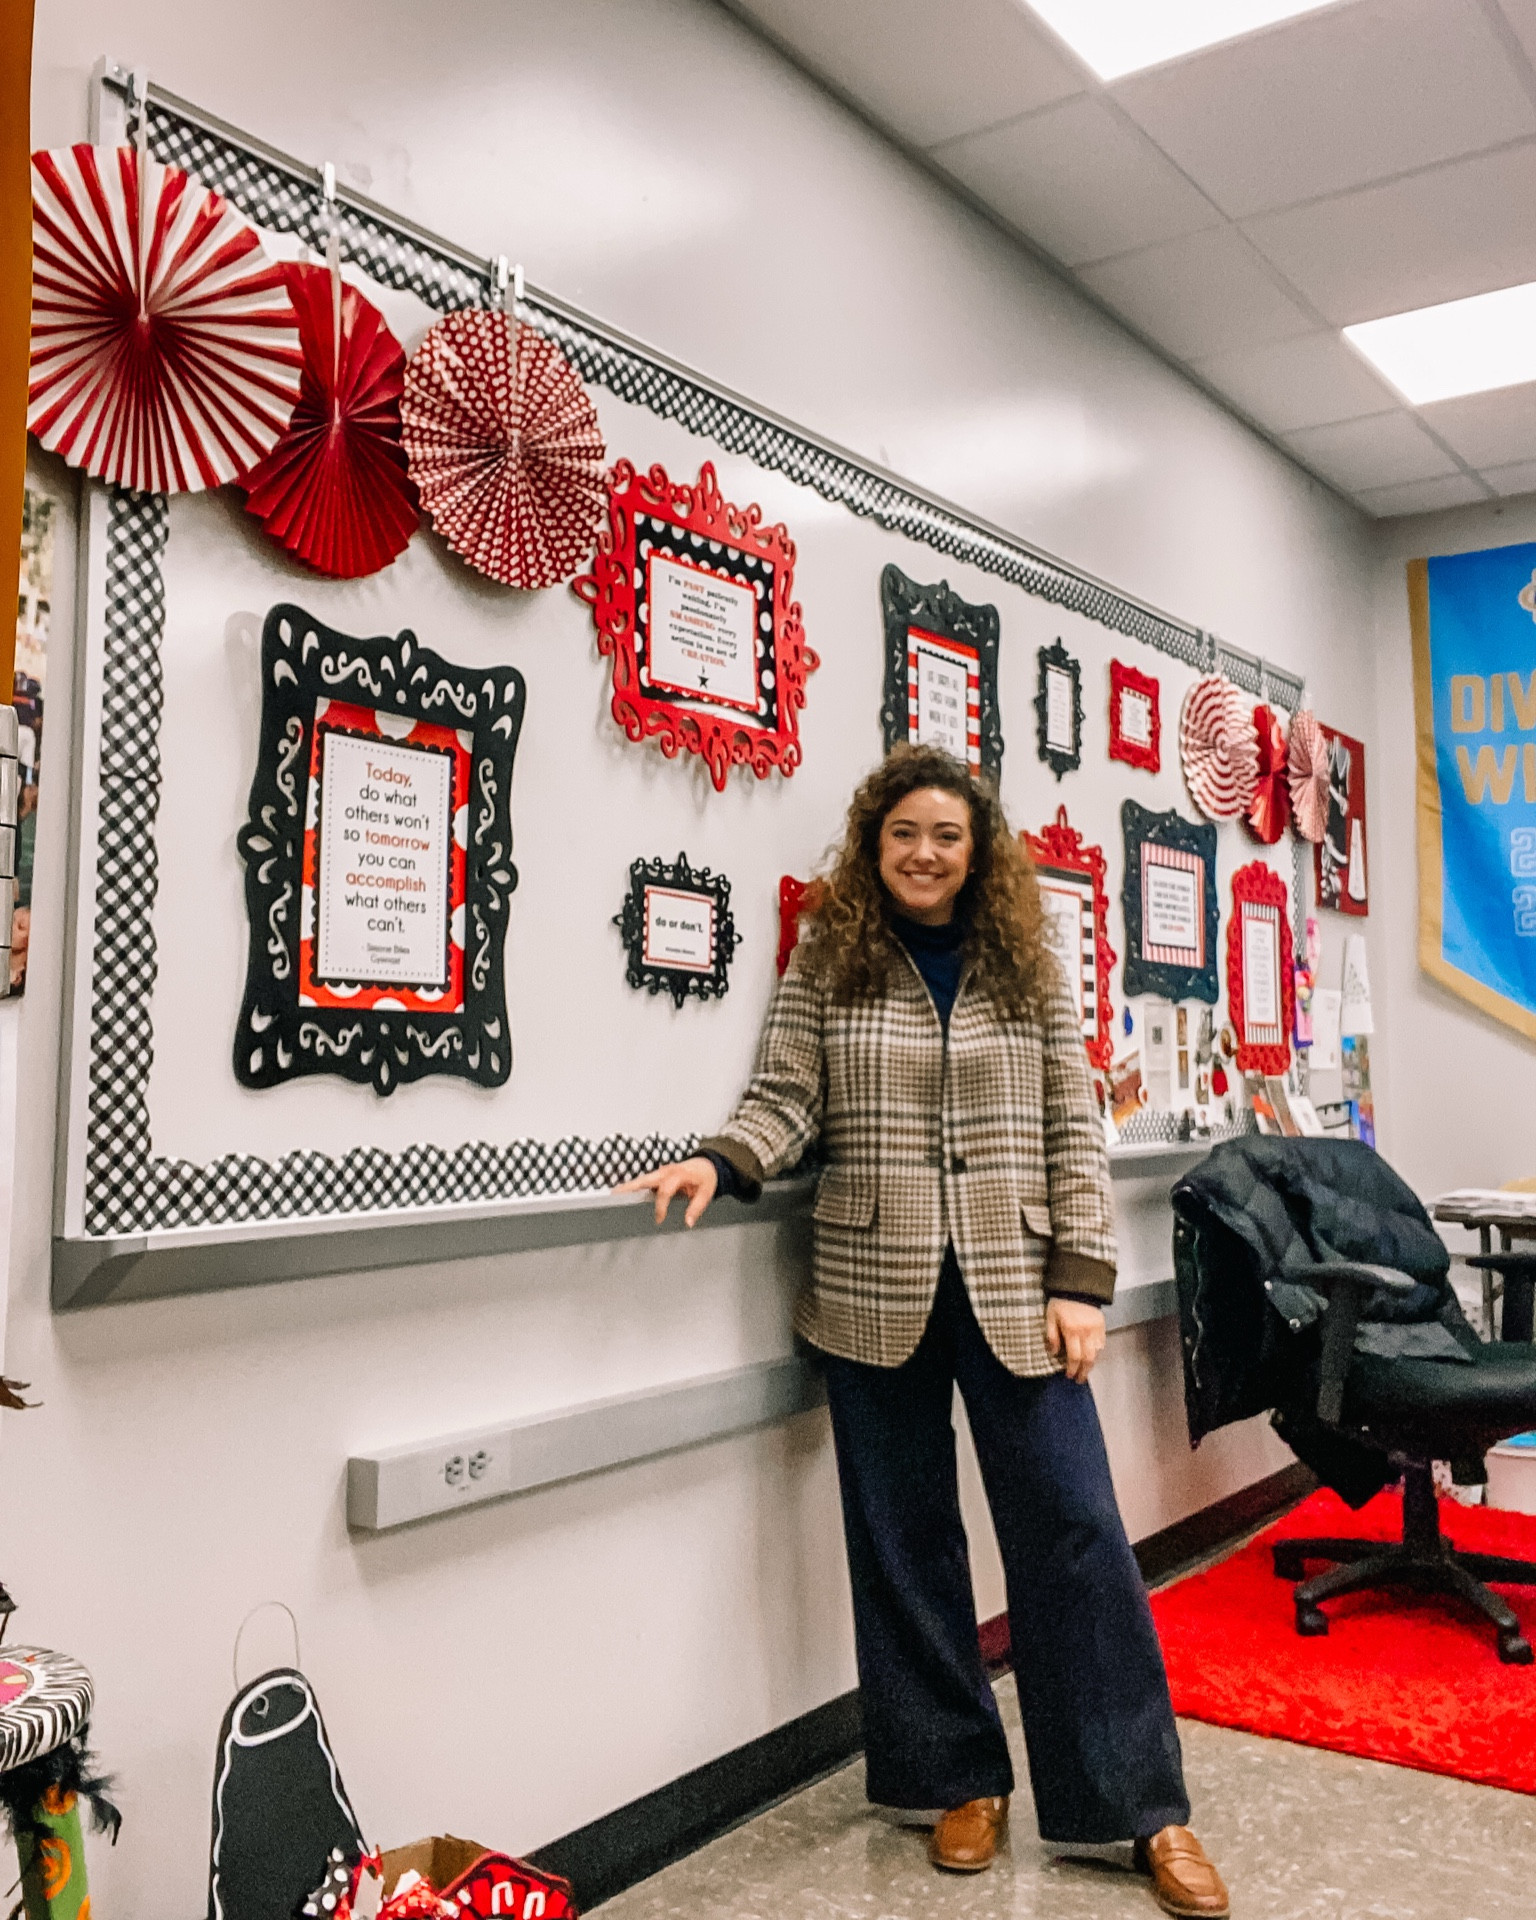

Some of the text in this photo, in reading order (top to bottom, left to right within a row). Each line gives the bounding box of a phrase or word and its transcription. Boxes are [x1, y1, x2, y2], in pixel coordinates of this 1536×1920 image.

[366, 761, 413, 788] Today,
[359, 784, 417, 808] do what
[345, 806, 430, 831] others won't
[344, 828, 430, 851] so tomorrow
[358, 852, 416, 870] you can
[346, 872, 426, 893] accomplish
[345, 891, 427, 914] what others
[367, 916, 405, 934] can't.
[655, 916, 667, 927] do
[669, 920, 678, 928] or
